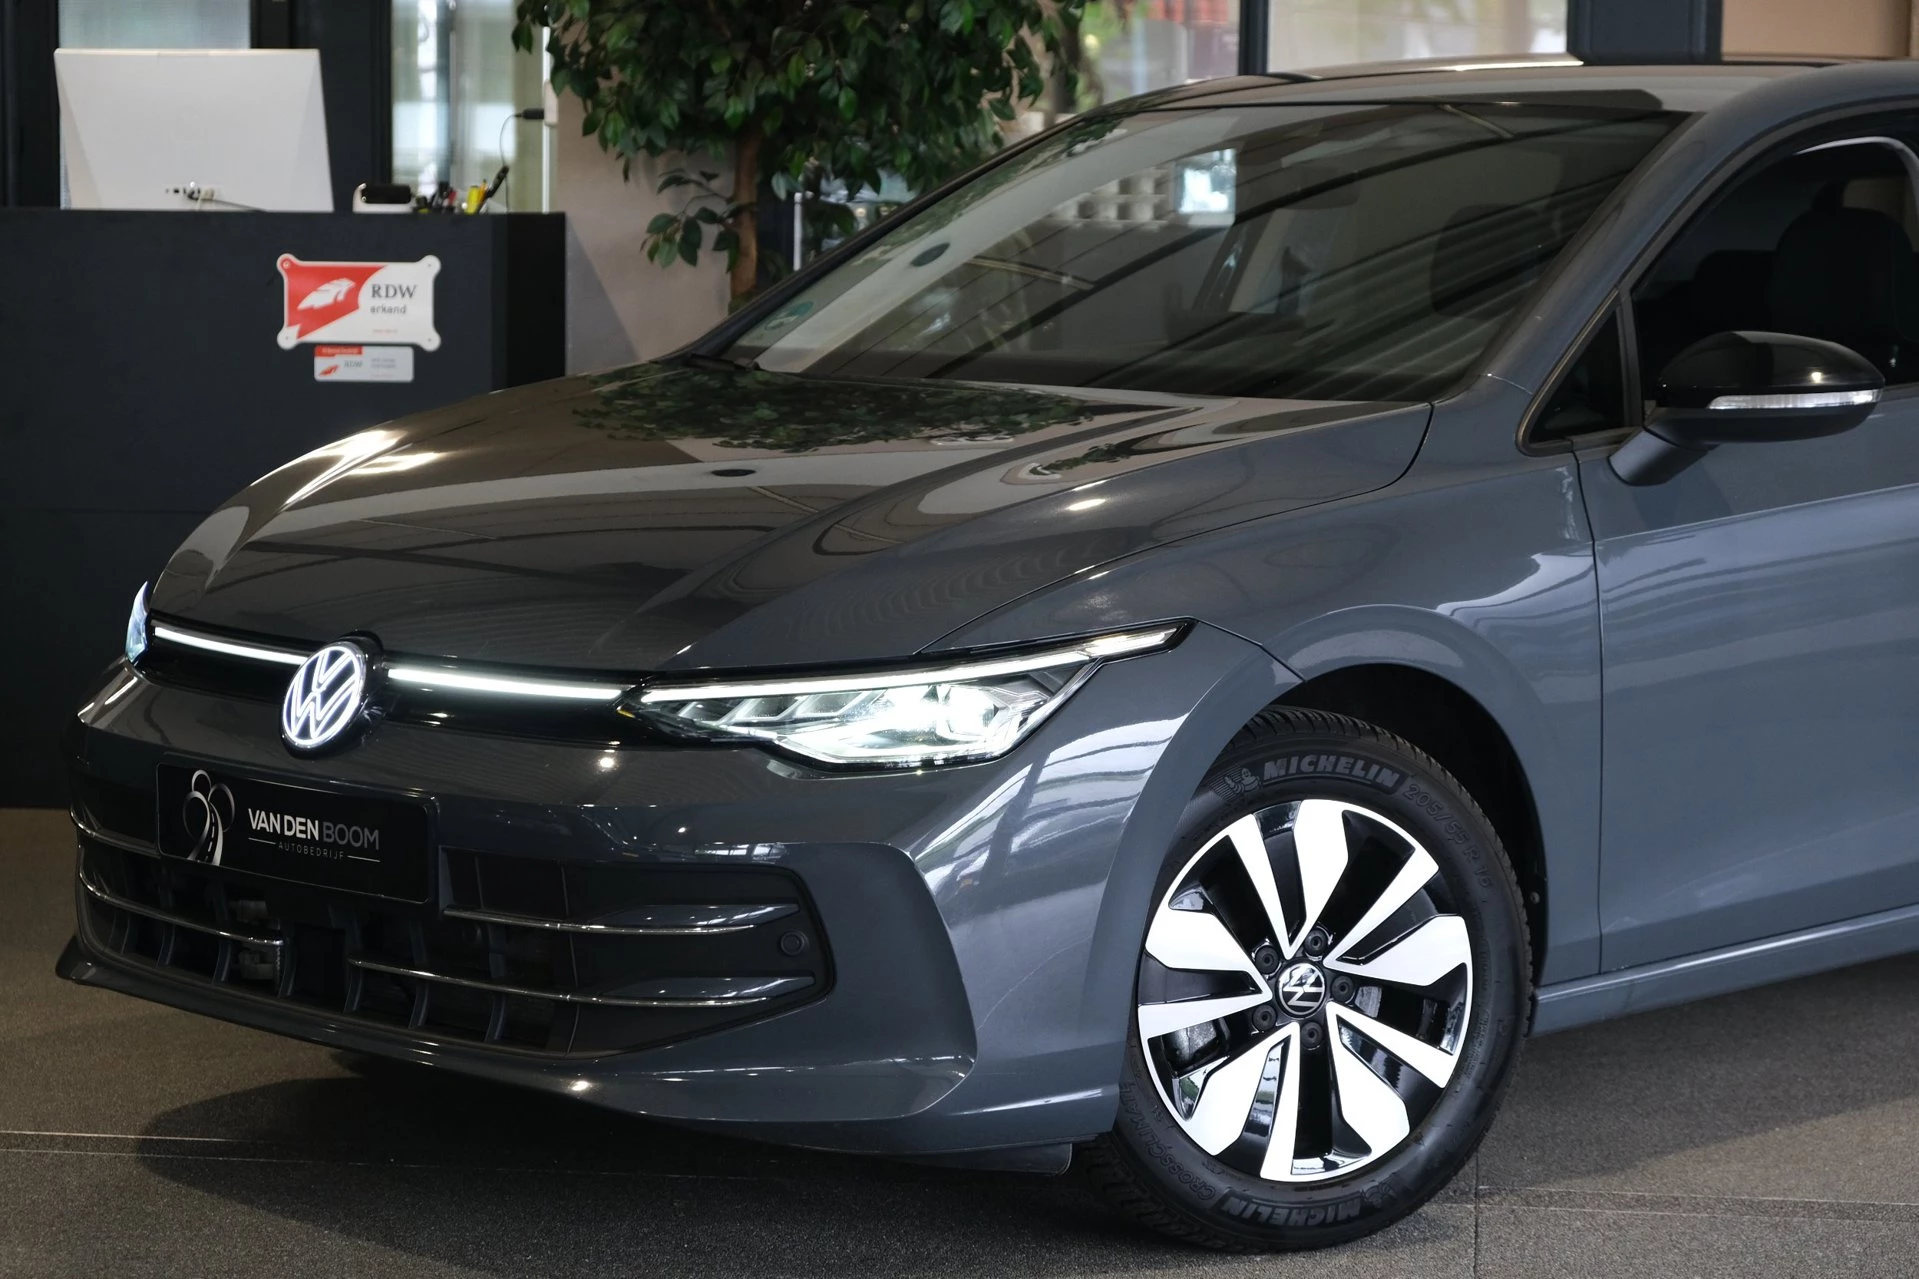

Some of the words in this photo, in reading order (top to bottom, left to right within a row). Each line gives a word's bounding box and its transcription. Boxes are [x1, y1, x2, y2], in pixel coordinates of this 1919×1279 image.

[371, 284, 416, 299] RDW
[1263, 754, 1401, 788] MICHELIN
[248, 808, 281, 834] VAN
[284, 815, 319, 841] DEN
[322, 821, 379, 850] BOOM
[1402, 783, 1470, 845] 205/55
[278, 841, 345, 859] AUTOBEDRIJF
[1220, 1196, 1361, 1227] MICHELIN
